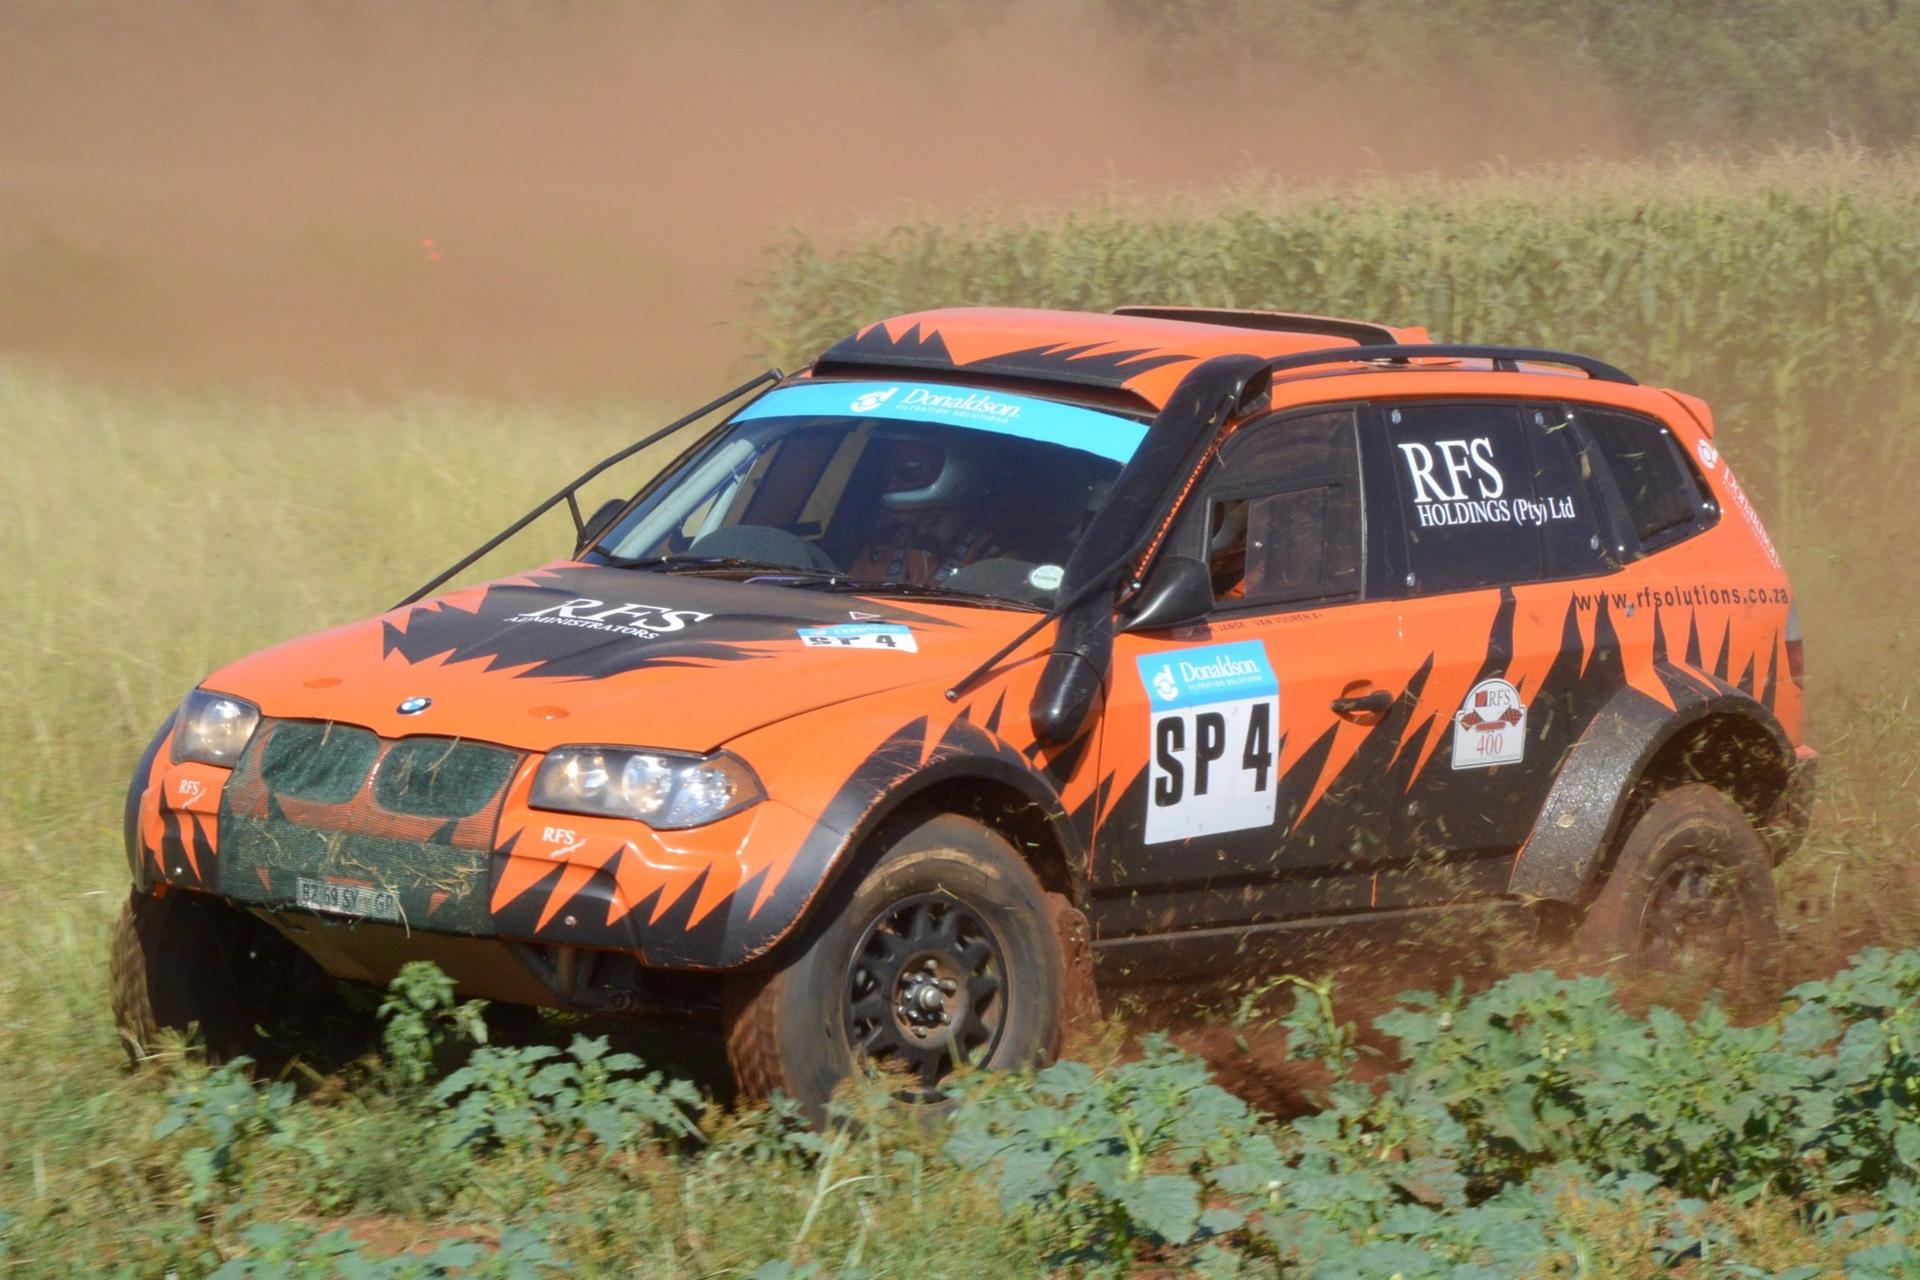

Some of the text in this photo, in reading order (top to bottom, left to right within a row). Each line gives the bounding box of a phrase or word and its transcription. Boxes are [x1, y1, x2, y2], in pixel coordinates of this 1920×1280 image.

[896, 403, 1009, 425] FILTRATION SOLUTIONS
[904, 387, 1021, 418] Donaldson
[1398, 437, 1504, 503] RFS
[1417, 496, 1576, 527] HOLDINGS (Pty) Ltd
[503, 615, 660, 640] ADMINISTRATORS
[517, 598, 713, 632] RFS
[876, 634, 897, 648] 4
[1179, 655, 1262, 683] Donaldson
[1488, 688, 1512, 707] RFS
[1154, 702, 1272, 808] SP 4
[1476, 731, 1503, 756] 400
[178, 779, 201, 796] RFS
[542, 826, 577, 846] RFS
